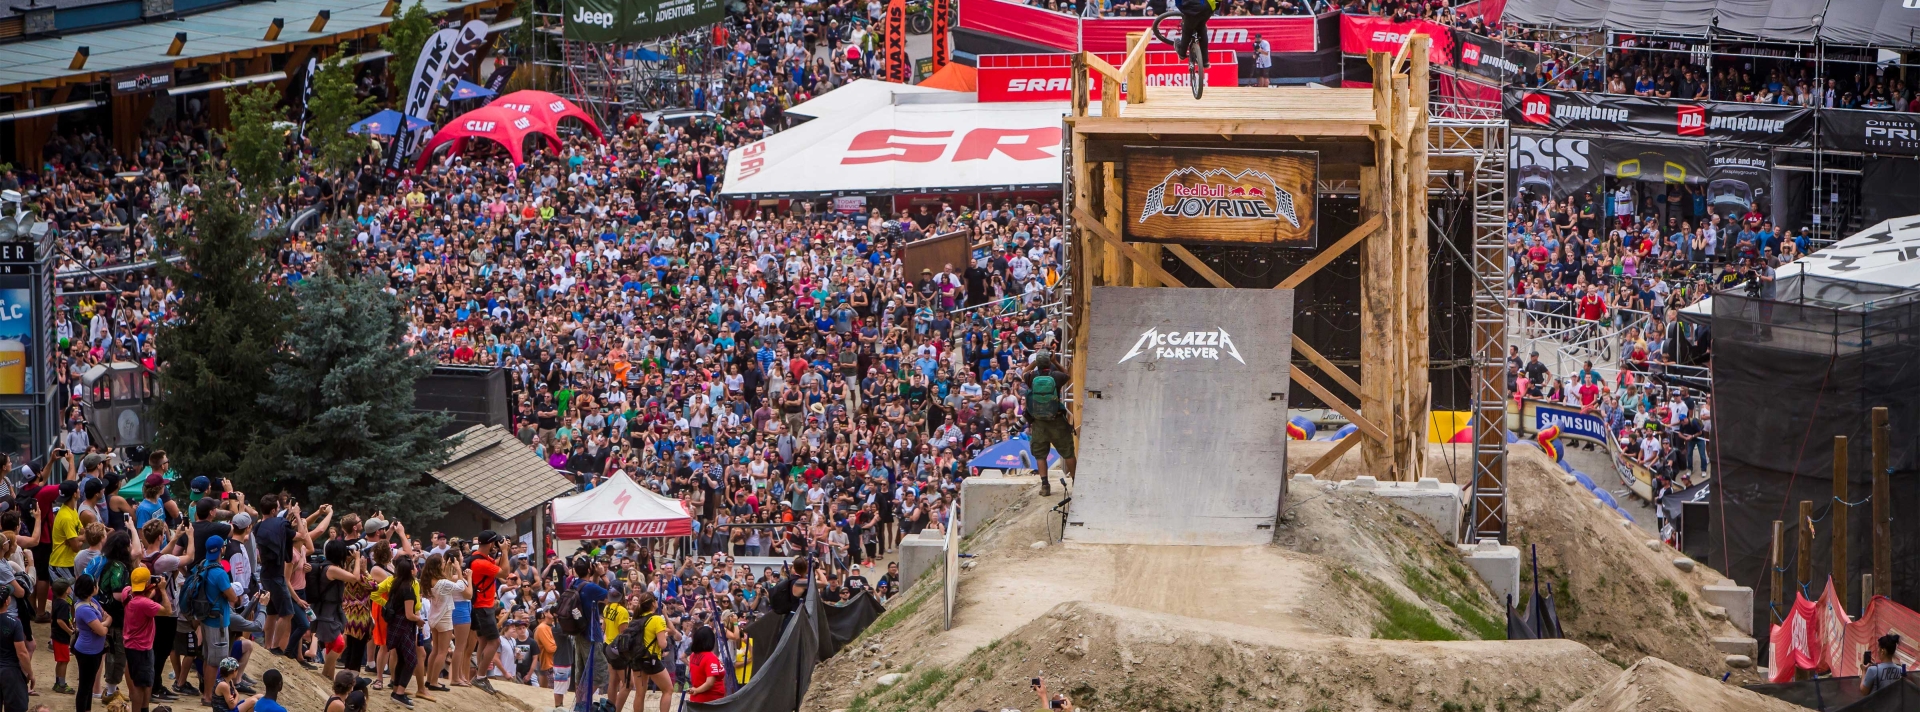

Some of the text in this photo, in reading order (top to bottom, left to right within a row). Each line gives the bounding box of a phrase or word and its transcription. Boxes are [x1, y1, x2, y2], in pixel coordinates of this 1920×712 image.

[573, 7, 613, 28] Jeep
[655, 4, 696, 22] ADVENTURE
[889, 6, 902, 80] MAXXIS
[1463, 48, 1478, 60] pb
[549, 100, 566, 114] CLIF
[1525, 101, 1629, 122] pb pinkbike
[466, 120, 496, 132] CLIF
[514, 116, 531, 130] CLIF
[1680, 113, 1785, 133] pb pinkbike
[1865, 139, 1892, 147] LENS
[1714, 156, 1725, 165] get
[1738, 157, 1751, 165] and
[1751, 158, 1766, 167] play
[1174, 183, 1225, 197] Red Bull
[1163, 198, 1280, 220] JOYRIDE
[1723, 273, 1737, 284] FOX
[1117, 326, 1246, 365] McGAZZA
[1155, 346, 1219, 361] FOREVER
[581, 521, 667, 537] SPECIALIZED
